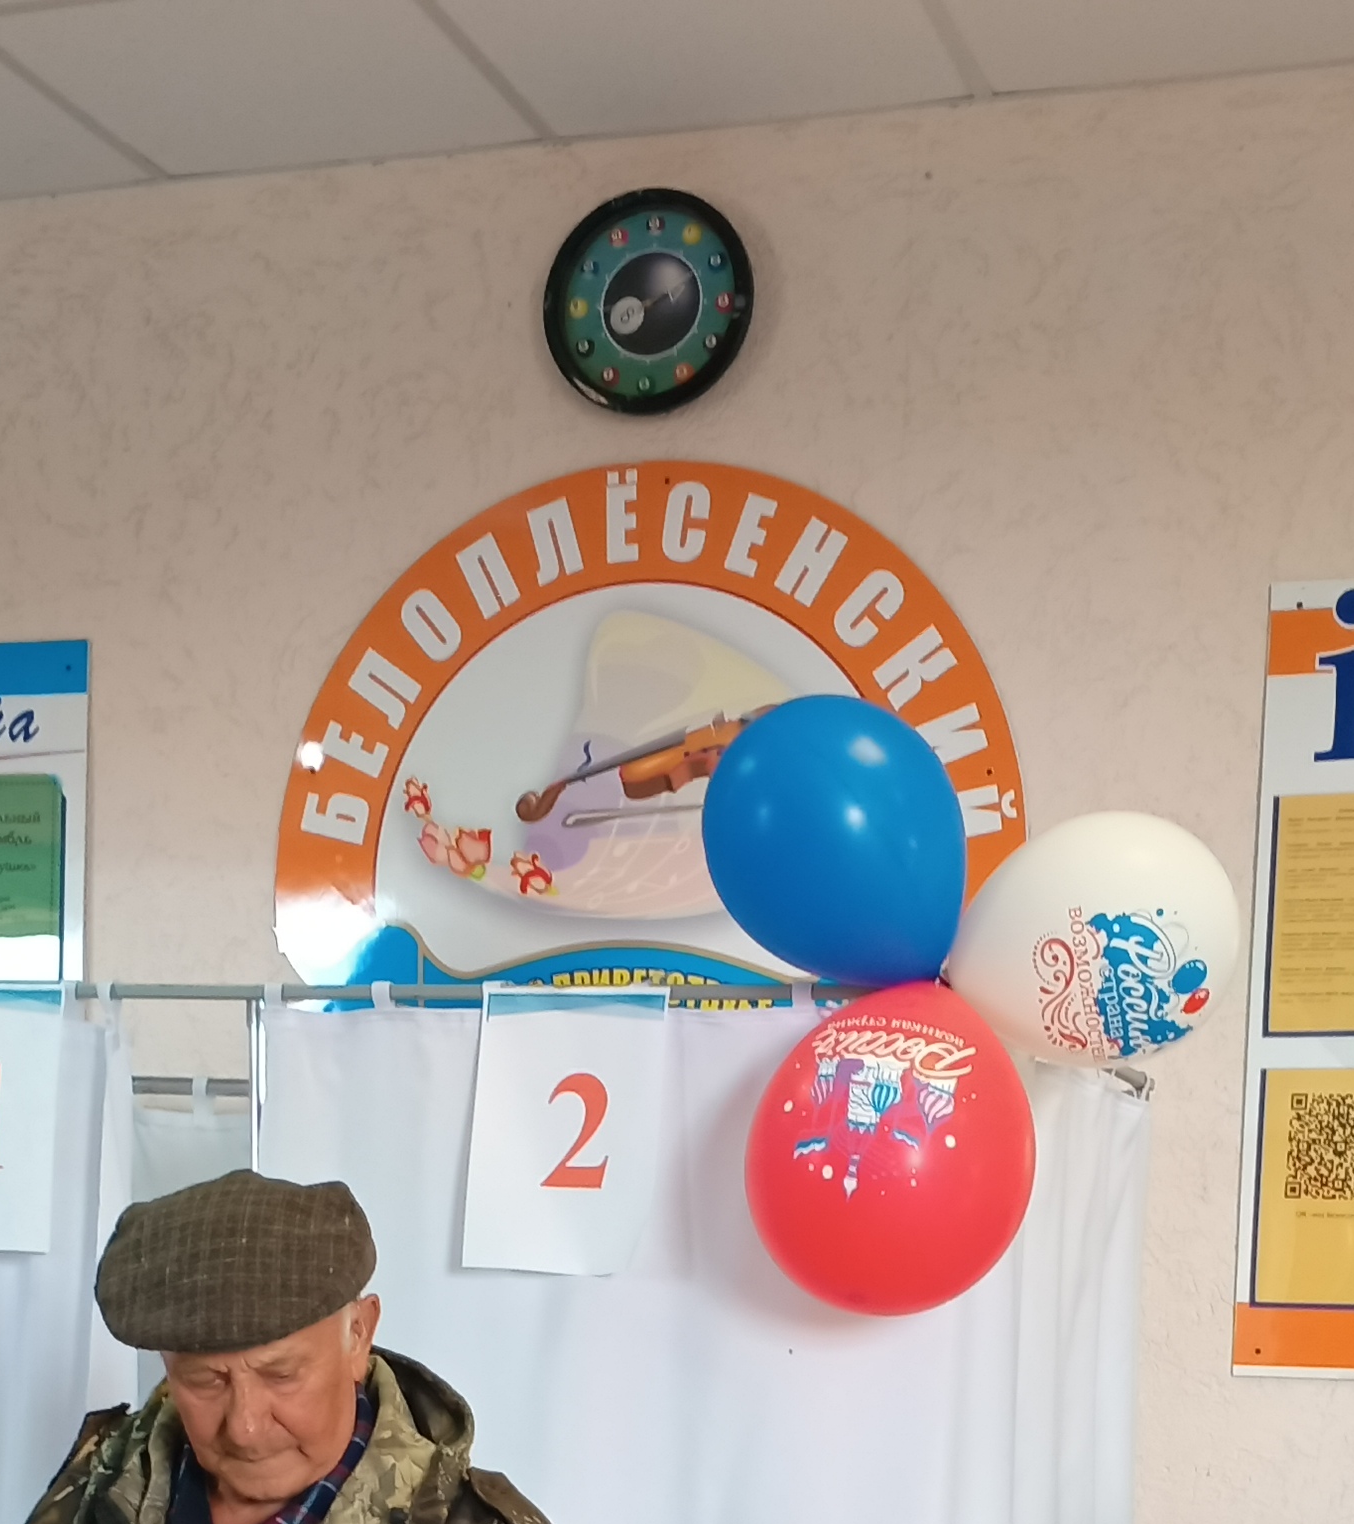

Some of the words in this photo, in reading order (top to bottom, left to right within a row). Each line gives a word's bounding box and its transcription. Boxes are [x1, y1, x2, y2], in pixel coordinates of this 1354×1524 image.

[299, 467, 1018, 847] БЕЛОПЛЁСЕНСКИЙ
[1098, 963, 1125, 1039] страна
[811, 1028, 977, 1079] Россия
[538, 1072, 610, 1190] 2
